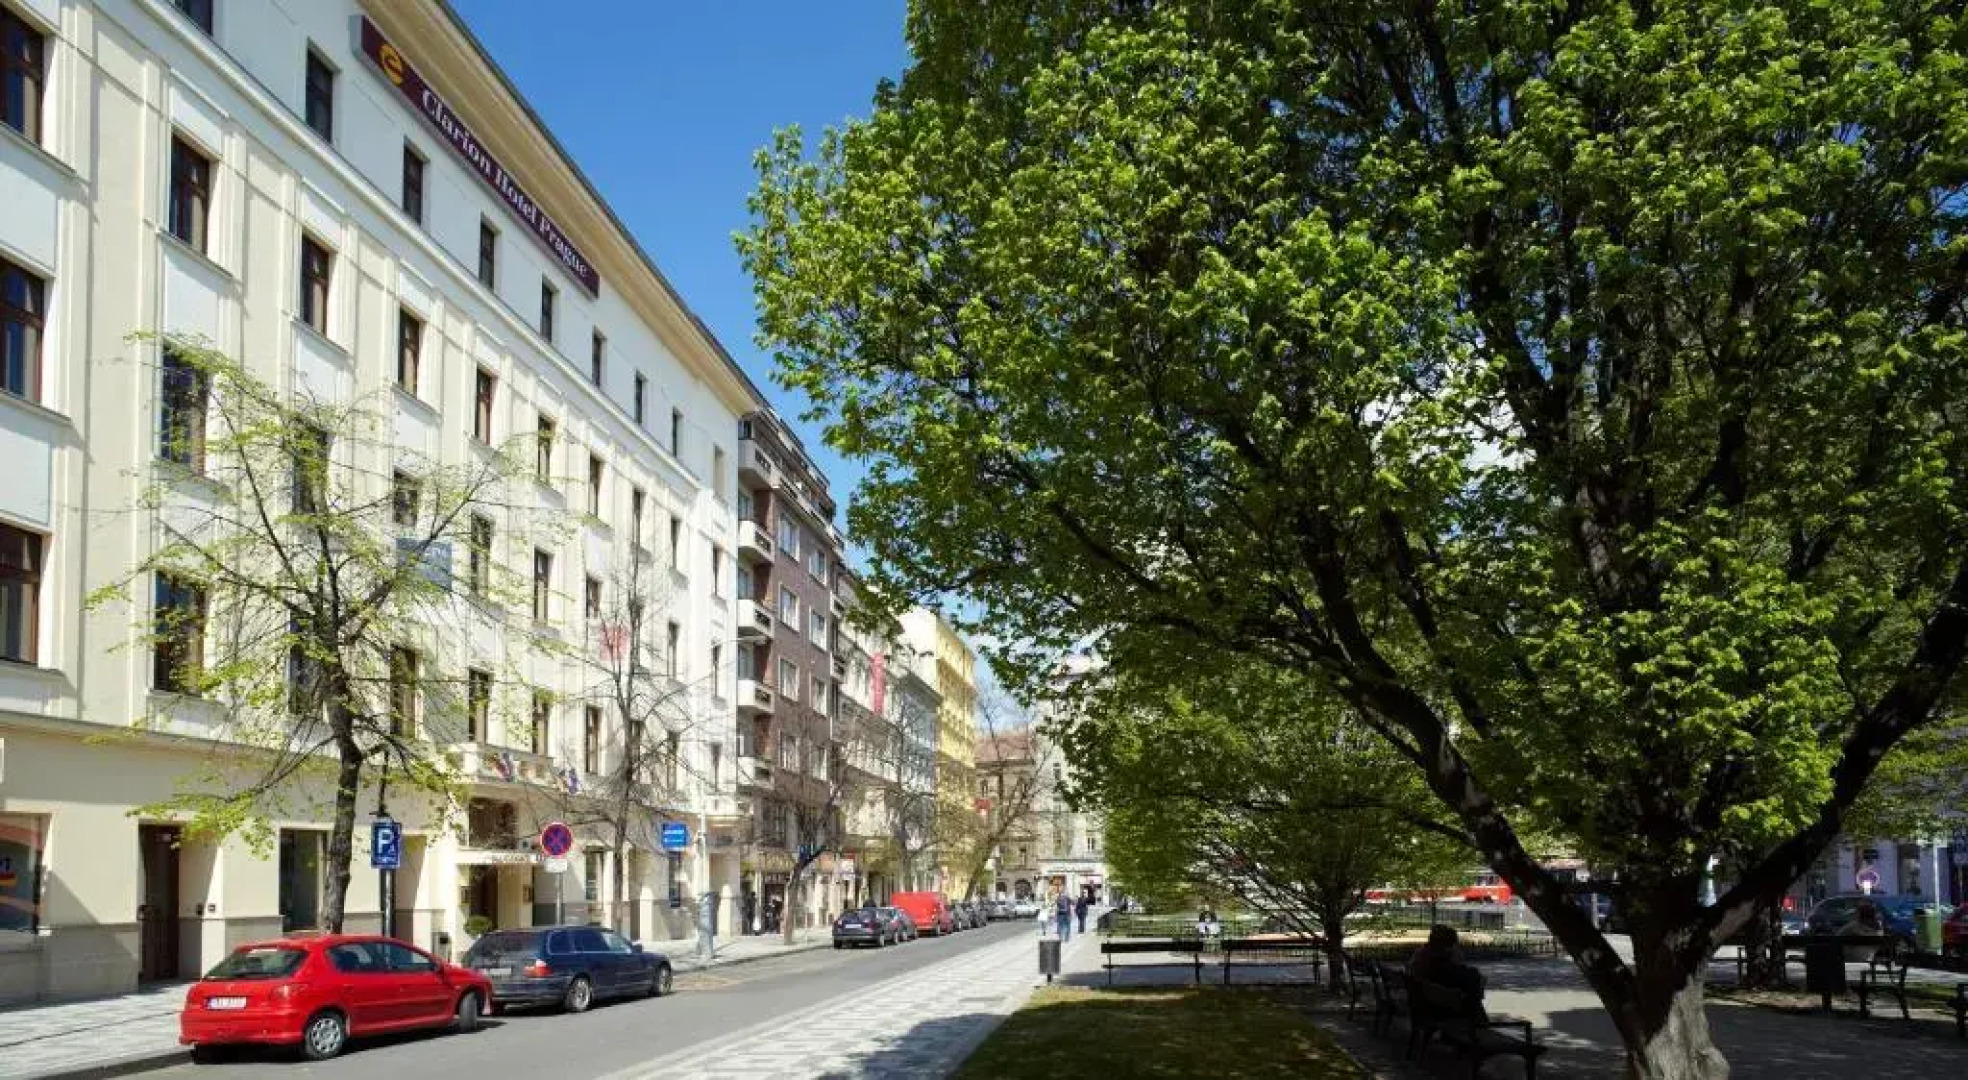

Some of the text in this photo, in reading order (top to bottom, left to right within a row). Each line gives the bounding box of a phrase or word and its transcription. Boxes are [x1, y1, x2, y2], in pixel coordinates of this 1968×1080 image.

[422, 88, 589, 279] Clarion Hotel Prague
[378, 829, 394, 854] P
